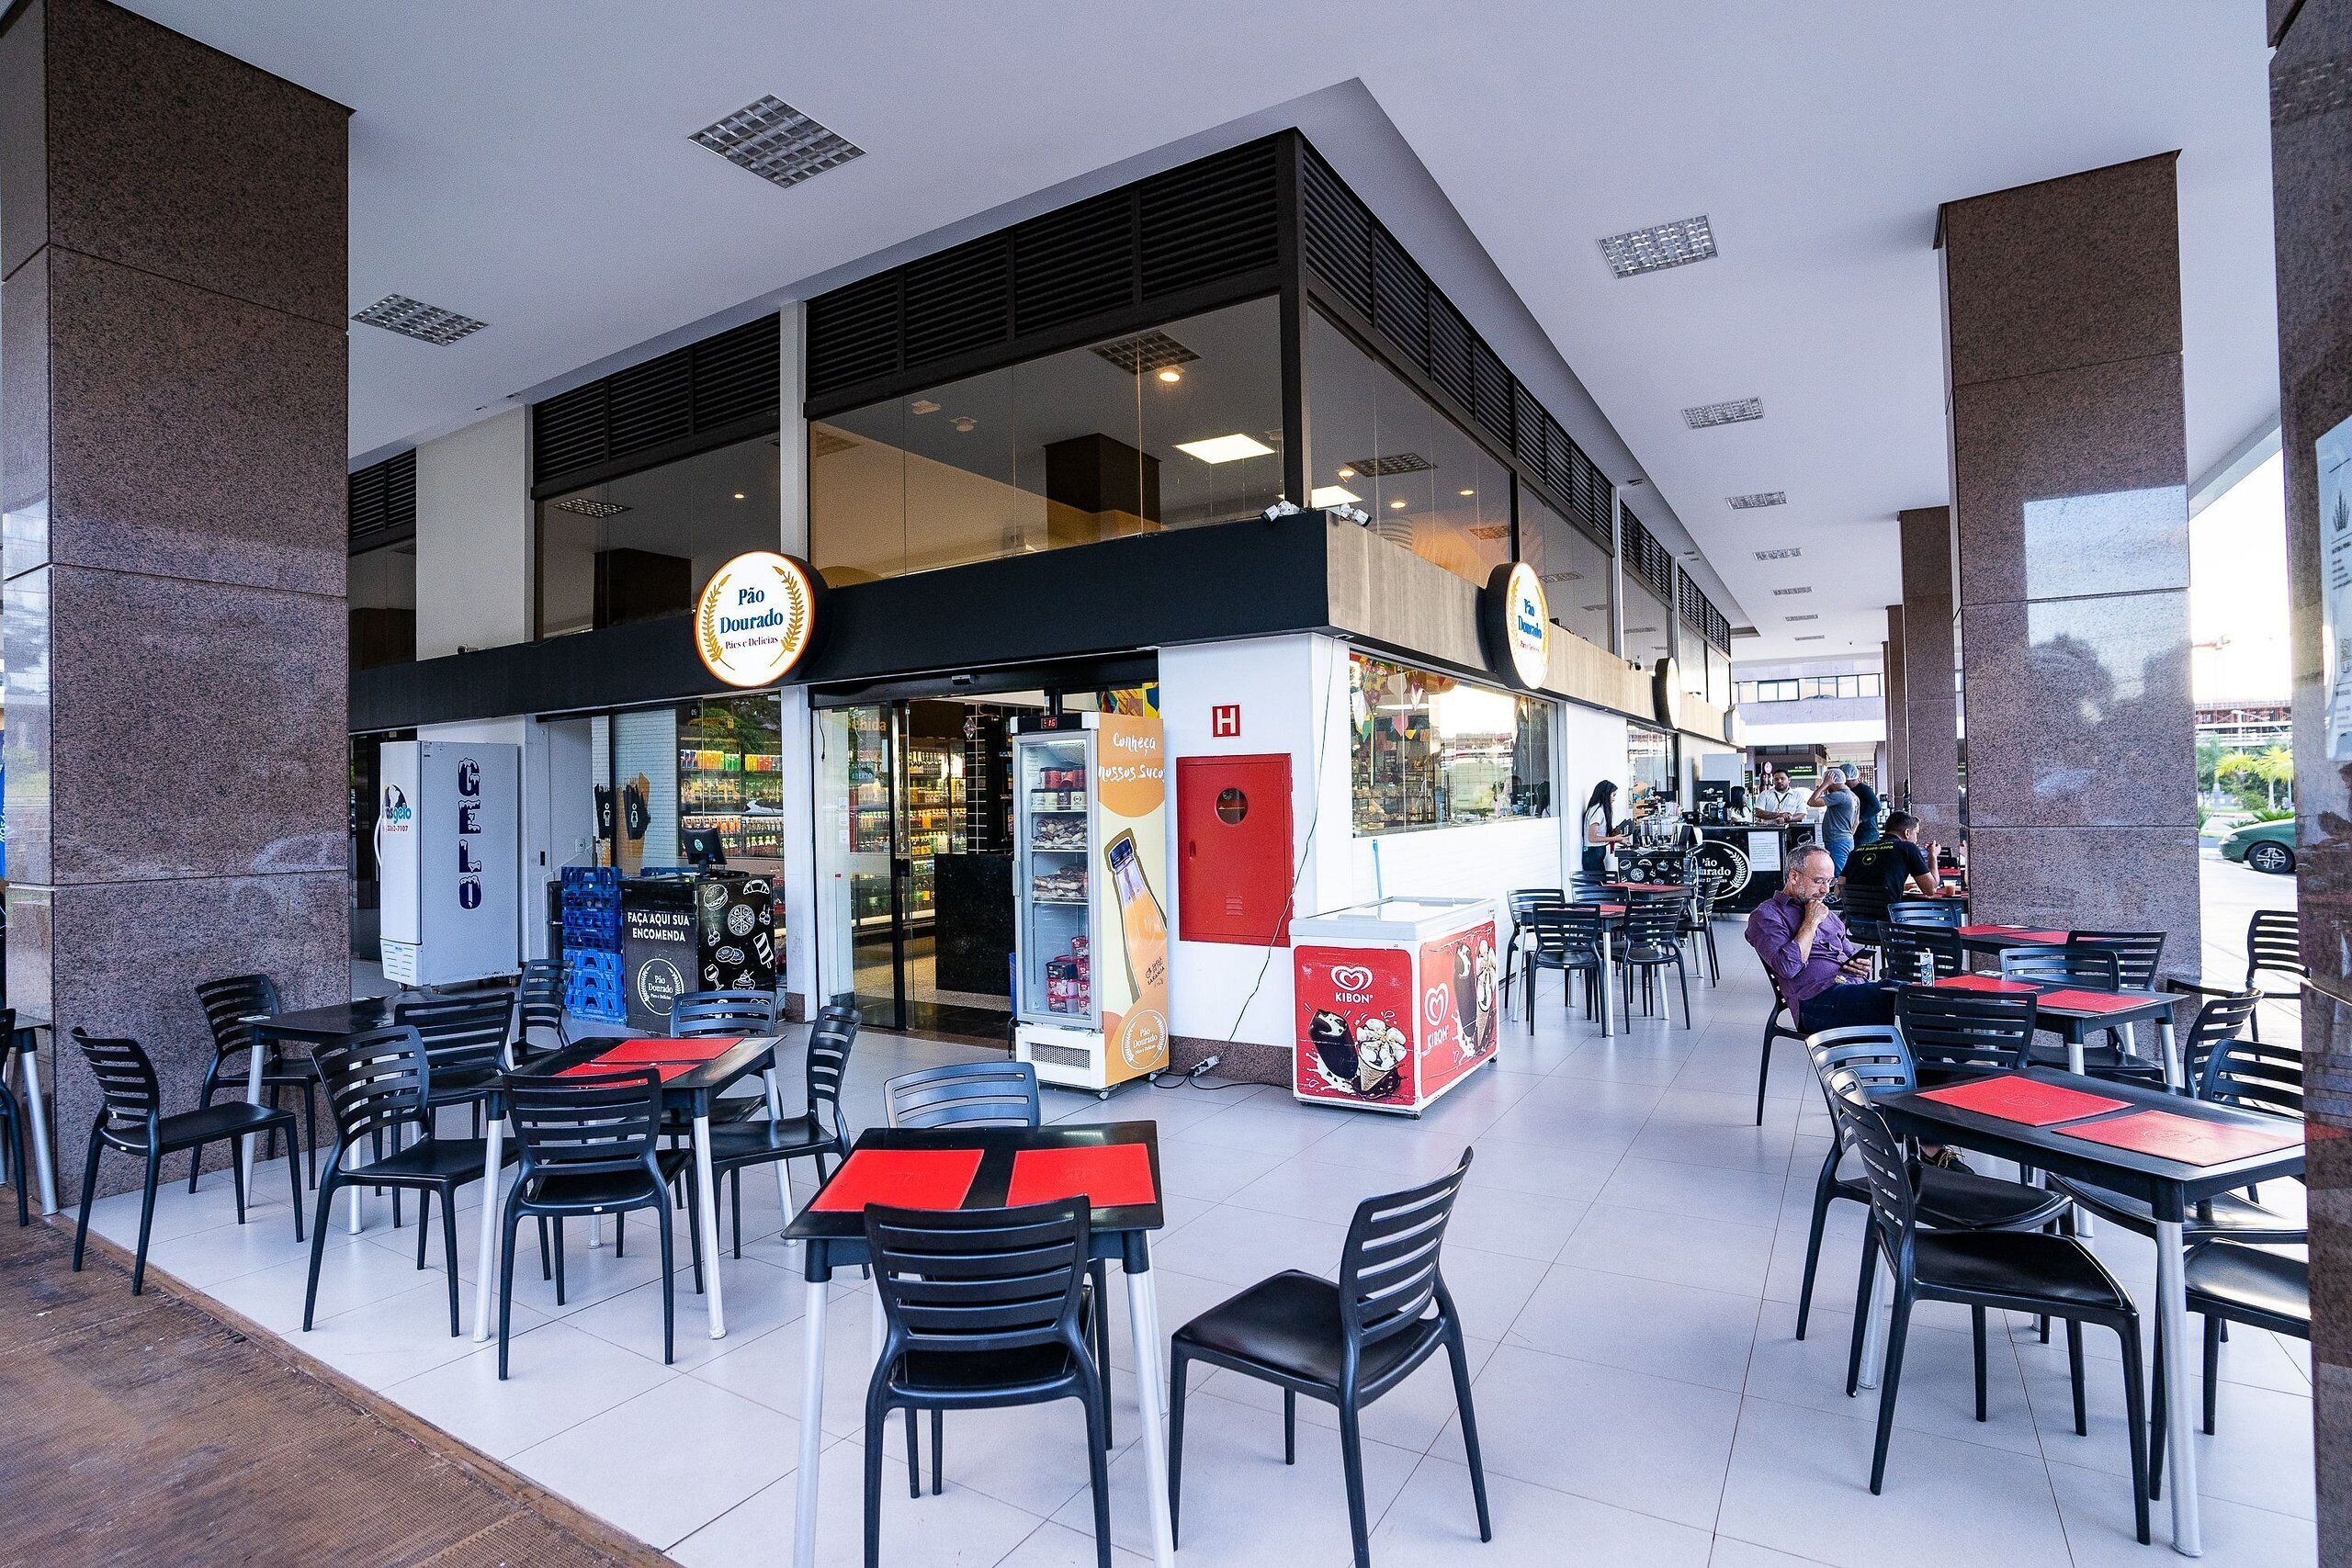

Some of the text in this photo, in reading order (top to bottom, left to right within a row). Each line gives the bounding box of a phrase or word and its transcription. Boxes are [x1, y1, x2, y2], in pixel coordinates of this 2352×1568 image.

[738, 587, 765, 605] Pão
[719, 607, 784, 634] Dourado
[1216, 707, 1237, 735] H
[1113, 732, 1157, 756] Conheça
[1098, 765, 1136, 783] nossos
[458, 758, 482, 909] GELO
[1699, 866, 1732, 876] urado
[628, 912, 690, 927] FAÇA AQUI SUA
[632, 928, 686, 942] ENCOMENDA
[1335, 992, 1370, 1004] KIBON
[1427, 1025, 1449, 1049] KIBON
